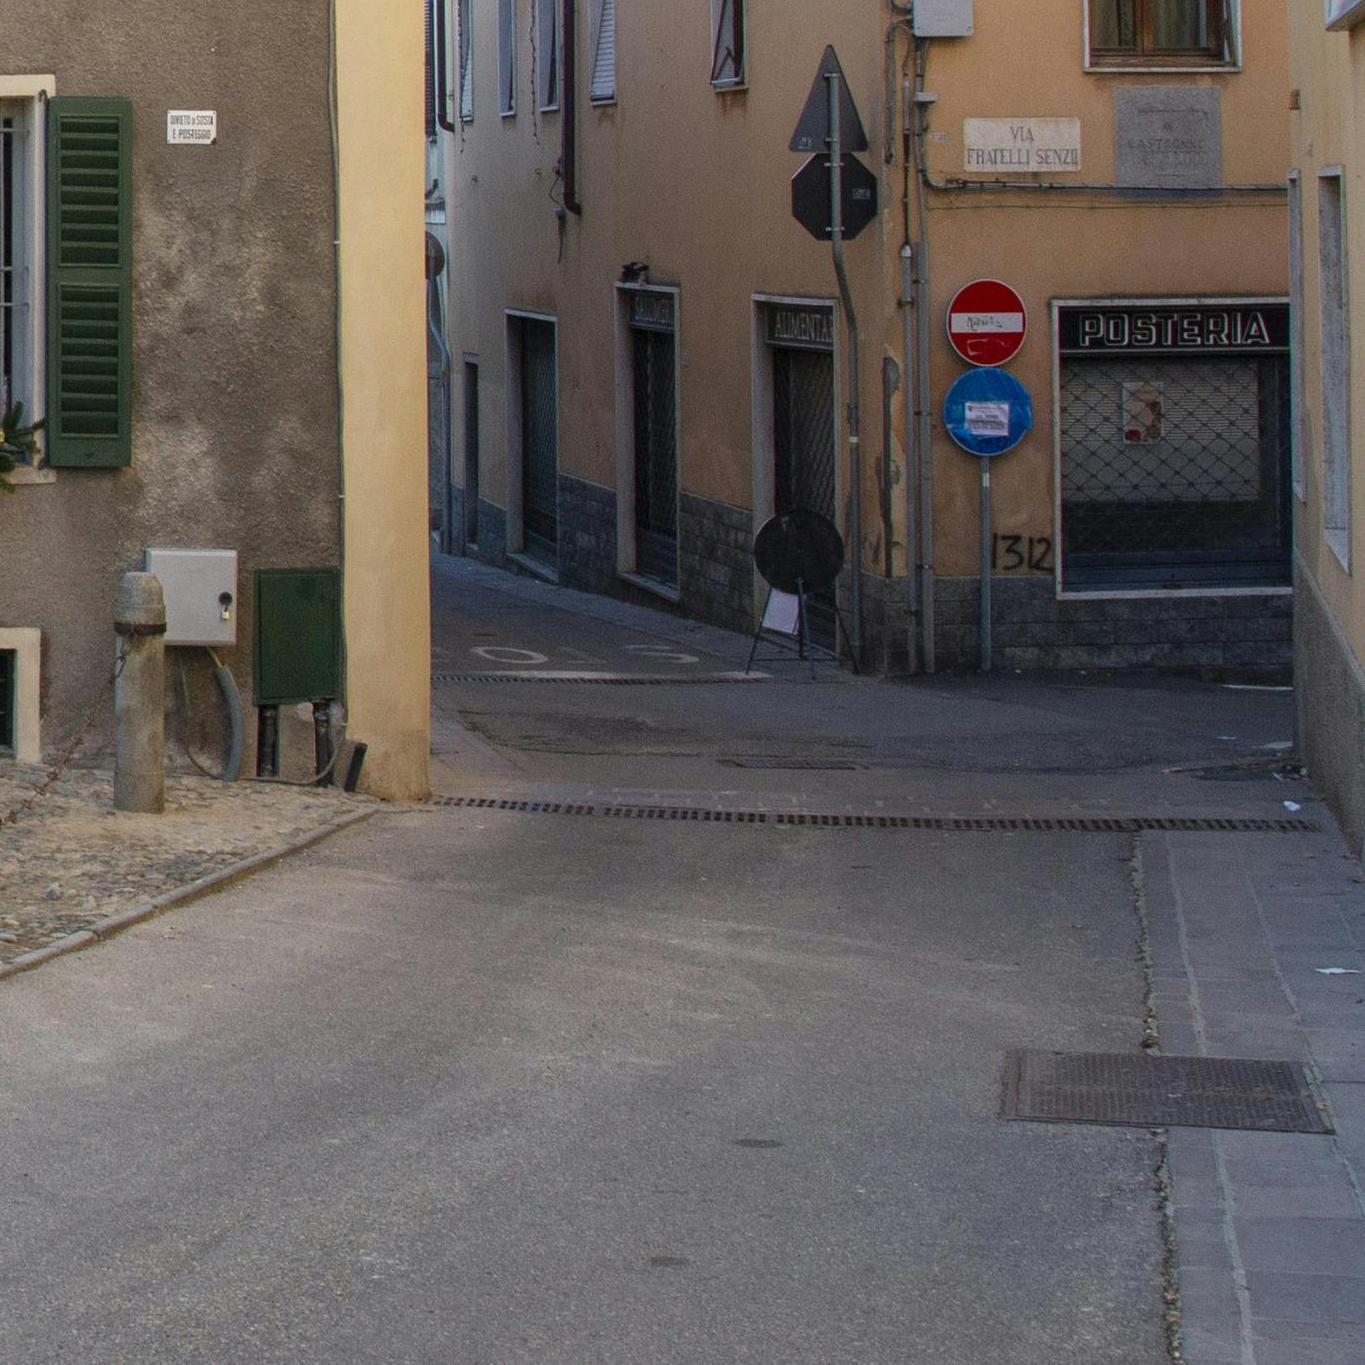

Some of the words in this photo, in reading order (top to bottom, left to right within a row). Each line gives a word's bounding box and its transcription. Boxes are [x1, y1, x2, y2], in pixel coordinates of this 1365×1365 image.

[171, 115, 190, 125] DIVIETO
[196, 115, 213, 125] SOSTA
[1010, 126, 1034, 141] VIA
[967, 148, 1030, 165] FRATELLI
[1080, 312, 1269, 346] POSTERIA
[992, 532, 1054, 572] 1312
